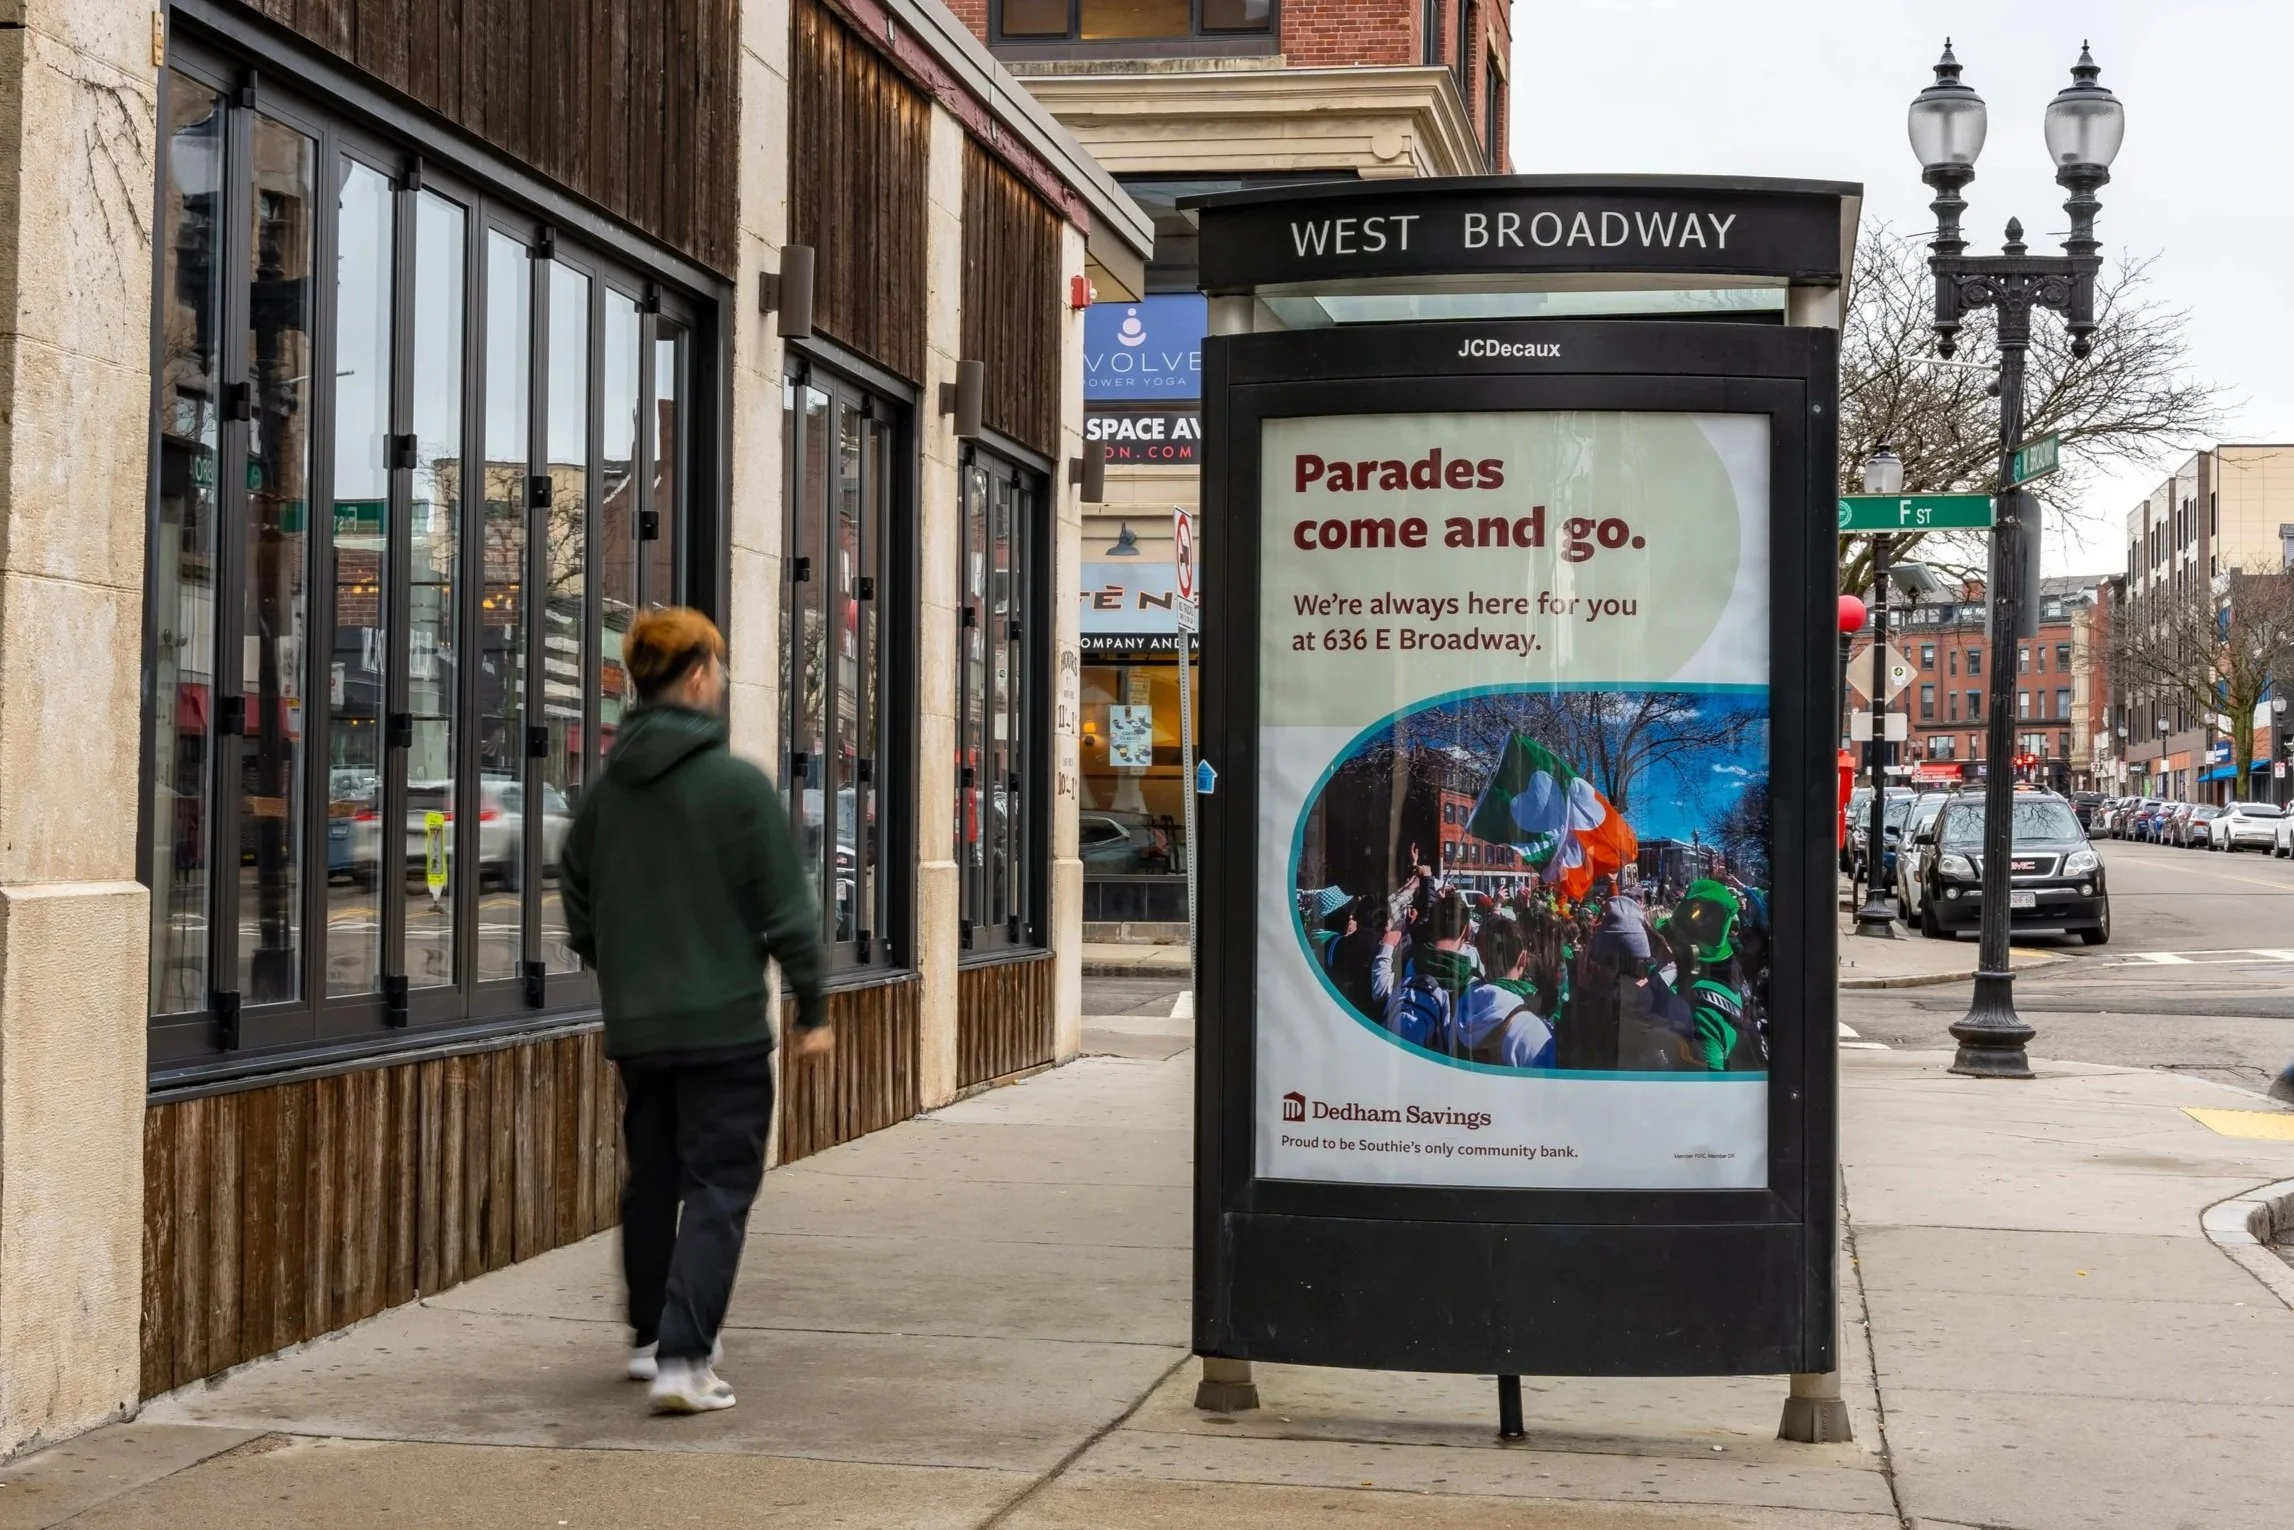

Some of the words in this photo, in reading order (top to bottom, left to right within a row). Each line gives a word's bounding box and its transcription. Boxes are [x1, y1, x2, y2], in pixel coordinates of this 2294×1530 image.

[1290, 214, 1420, 257] WEST
[1463, 211, 1737, 250] BROADWAY
[1457, 338, 1561, 359] JCDecaux
[1084, 378, 1135, 387] OWER
[1144, 377, 1187, 386] YOGA
[1086, 417, 1165, 441] SPACE
[1295, 447, 1505, 493] Parades
[1900, 500, 1912, 525] F
[1916, 508, 1932, 525] ST
[1293, 517, 1428, 551] come
[1444, 505, 1546, 549] and
[1560, 517, 1646, 563] go.
[1293, 593, 1362, 616] We're
[1370, 592, 1459, 621] always
[1468, 591, 1529, 615] here
[1538, 591, 1579, 615] for
[1586, 598, 1637, 622] you
[1292, 631, 1316, 651] at
[1323, 628, 1368, 651] 636
[1376, 628, 1391, 650] E
[1400, 627, 1542, 657] Broadway.
[2011, 861, 2036, 870] MC
[1312, 1101, 1402, 1123] Dedham
[1406, 1106, 1492, 1130] Savings
[1281, 1135, 1319, 1149] Proud
[1322, 1138, 1336, 1150] to
[1340, 1137, 1355, 1150] be
[1359, 1139, 1421, 1153] Southie's
[1425, 1141, 1454, 1158] only
[1457, 1143, 1537, 1160] community
[1540, 1144, 1579, 1158] bank.
